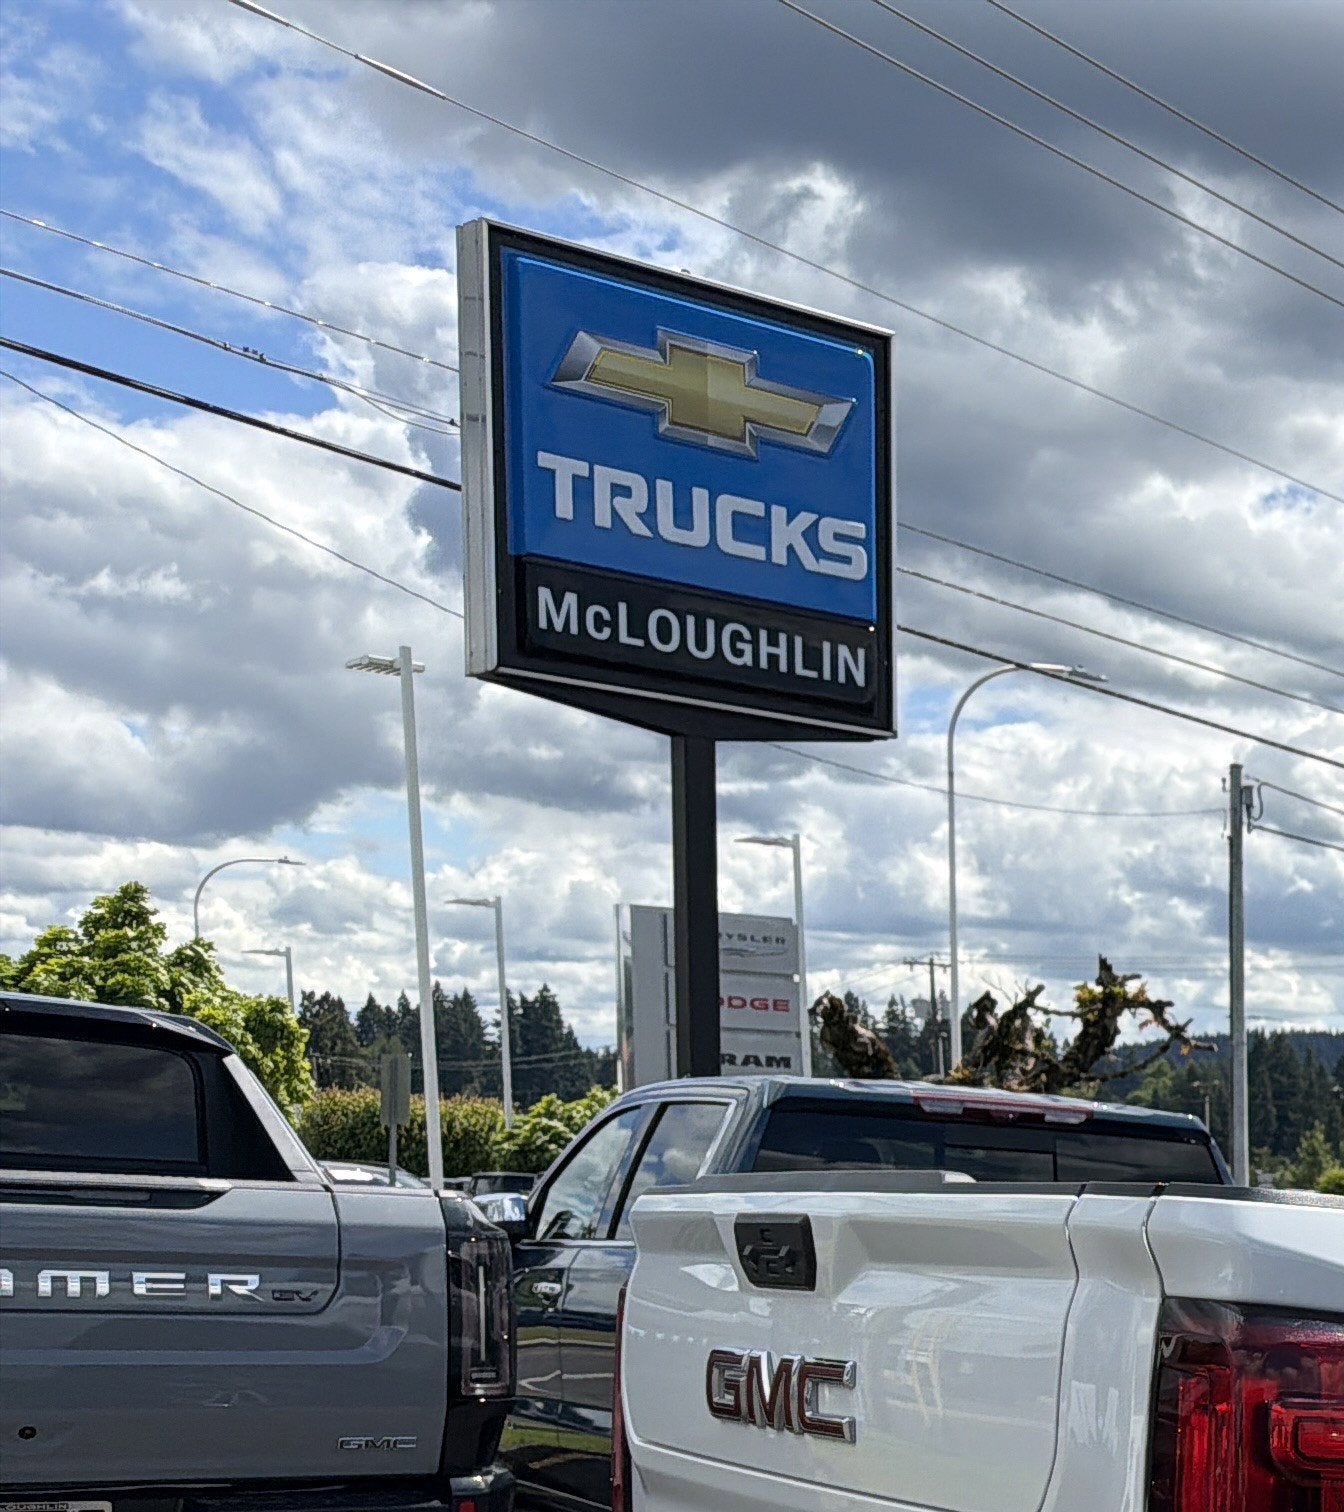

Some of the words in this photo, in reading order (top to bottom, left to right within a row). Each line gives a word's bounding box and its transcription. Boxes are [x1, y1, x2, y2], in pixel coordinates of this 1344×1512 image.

[537, 451, 868, 581] TRUCKS
[537, 586, 866, 687] McLOUGHLIN
[720, 1053, 792, 1069] RAM
[0, 1268, 264, 1302] MER
[706, 1349, 857, 1445] GMC
[337, 1436, 417, 1450] GMC
